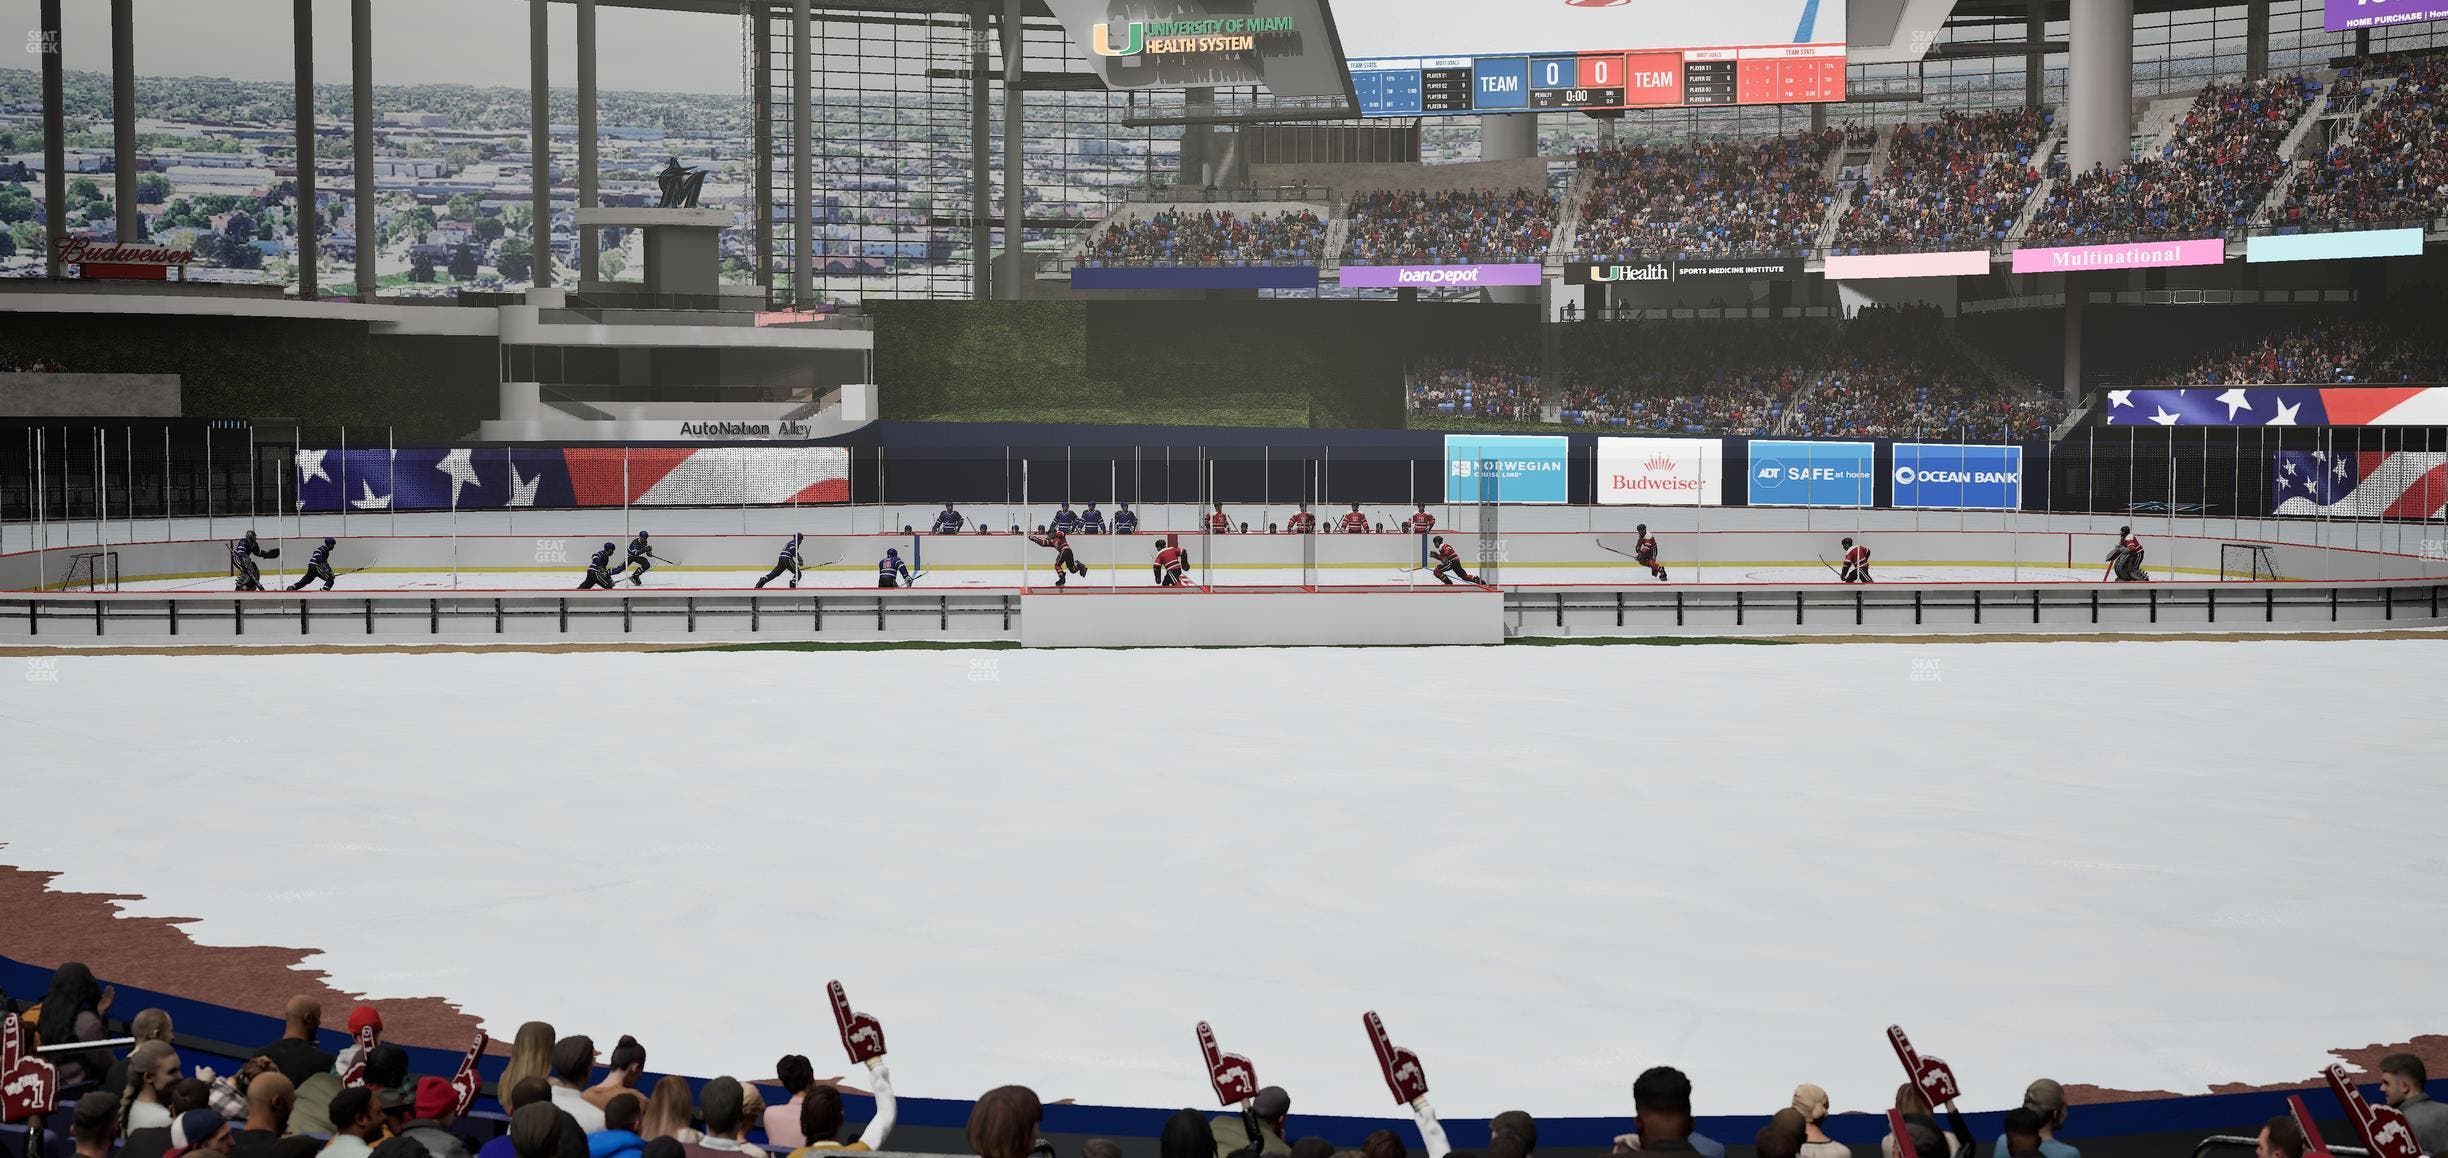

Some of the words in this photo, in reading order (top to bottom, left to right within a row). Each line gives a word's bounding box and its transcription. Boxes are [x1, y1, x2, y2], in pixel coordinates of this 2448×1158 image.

[1144, 19, 1223, 36] UNIVERSITY
[1224, 18, 1242, 33] OF
[1247, 16, 1293, 32] MIAMI
[2346, 18, 2372, 27] HOME
[2374, 12, 2422, 24] PURCHASE
[1146, 38, 1196, 54] HEALTH
[1200, 36, 1253, 52] SYSTEM
[1546, 62, 1558, 86] 0
[1595, 61, 1607, 84] 0
[1634, 71, 1672, 88] TEAM
[1481, 76, 1518, 92] TEAM
[1566, 90, 1588, 102] 0:00
[53, 236, 193, 264] Budweiser
[2052, 246, 2180, 267] Multinational
[1398, 268, 1478, 284] loanDepot
[680, 422, 770, 435] AutoNation
[778, 421, 812, 438] Alley
[1474, 462, 1560, 470] NORWEGIAN
[1758, 468, 1780, 478] ADT
[1788, 468, 1834, 480] SAFE
[1612, 475, 1706, 490] Budweiser
[1919, 471, 1970, 482] OCEAN
[1974, 472, 2018, 483] BANK
